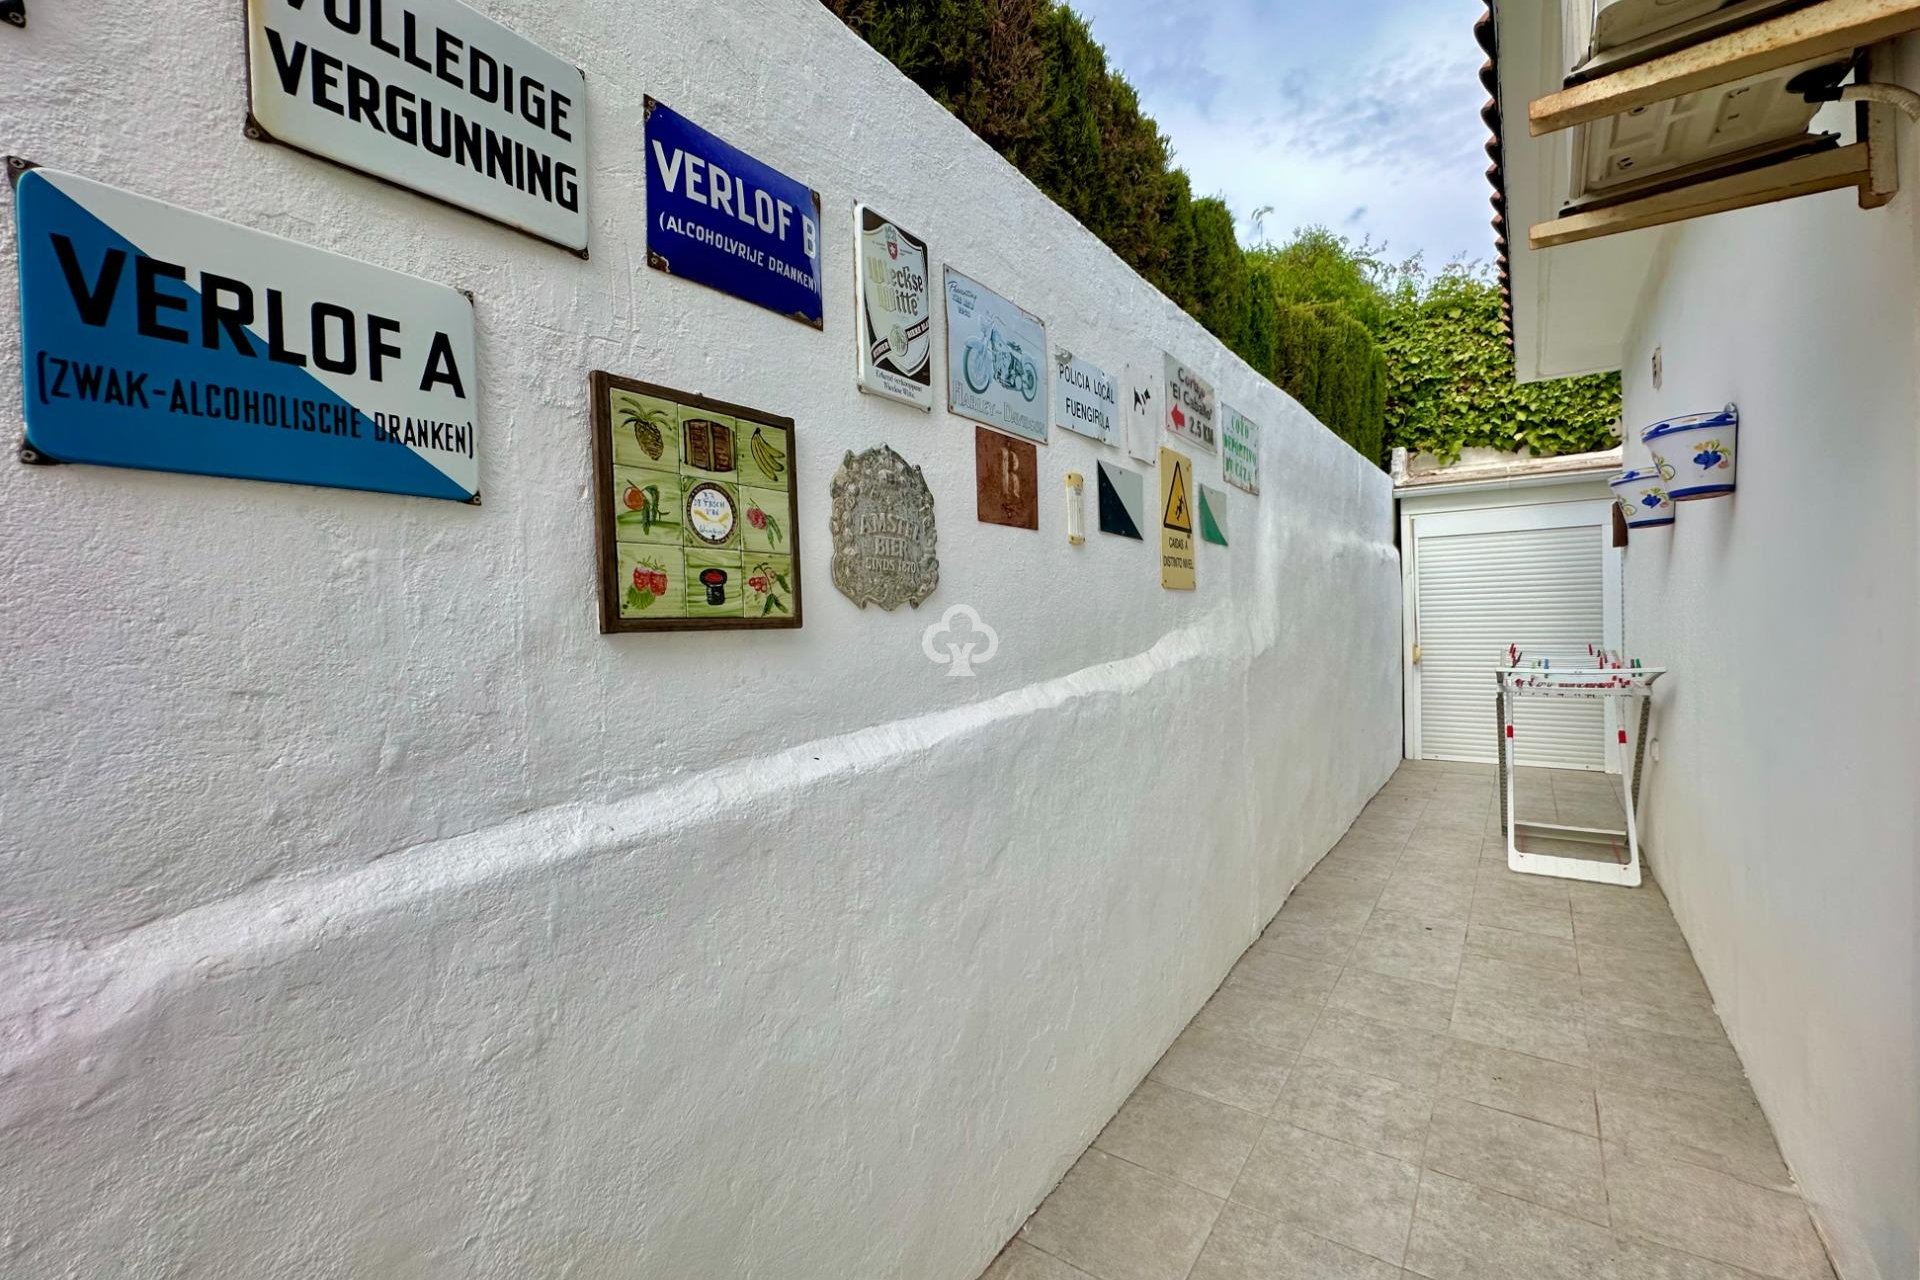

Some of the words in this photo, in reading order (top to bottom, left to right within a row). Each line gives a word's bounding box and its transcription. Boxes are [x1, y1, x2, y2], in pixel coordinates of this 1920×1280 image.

[287, 0, 572, 143] OLLEDIGE
[264, 27, 578, 214] VERGUNNING
[652, 139, 793, 241] VERLOF
[802, 214, 816, 259] B
[659, 211, 764, 267] (ALCOHOLVRIJE
[769, 256, 817, 294] DRANKEN)
[50, 233, 401, 382] VERLOF
[419, 331, 466, 399] A
[877, 285, 919, 316] Witte
[37, 350, 361, 439] (ZWAK-ALCOHOLISCHE
[374, 411, 474, 459] DRANKEN)
[1059, 363, 1091, 393] POLICIA
[1093, 379, 1115, 404] LOCAL
[1065, 397, 1110, 432] FUENGIROLA
[859, 512, 920, 543] AMSTEL
[874, 535, 908, 559] BIER
